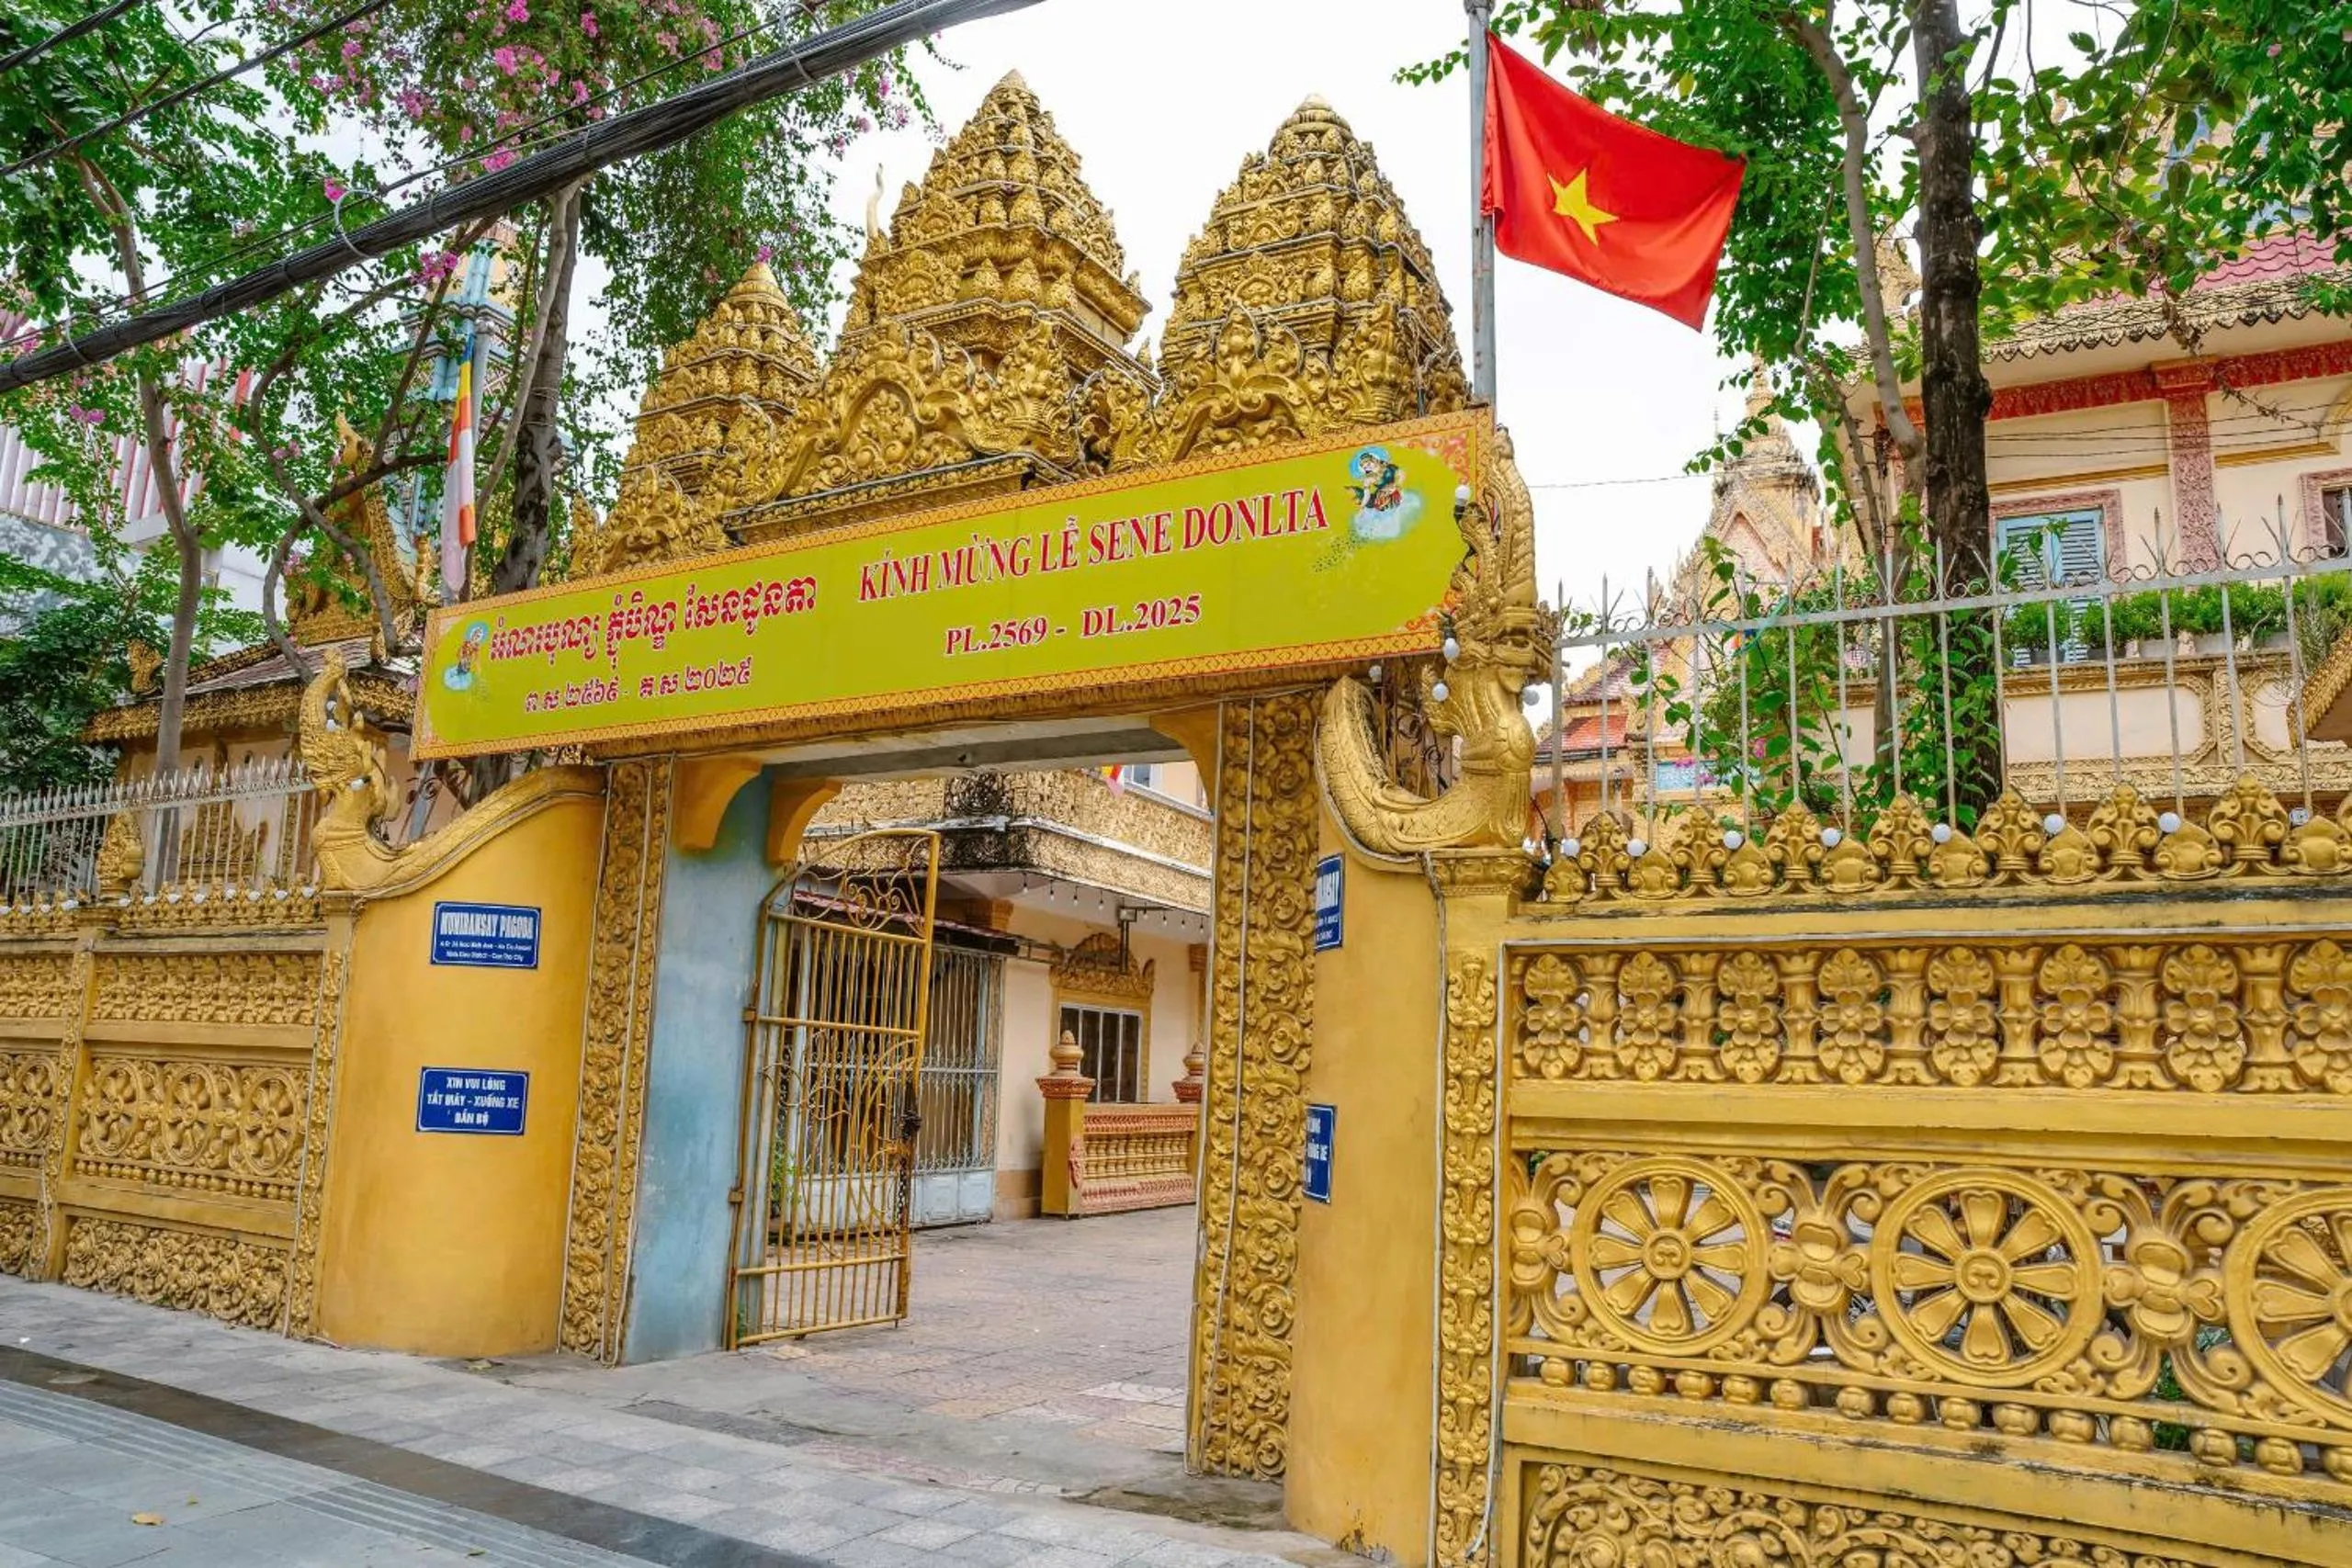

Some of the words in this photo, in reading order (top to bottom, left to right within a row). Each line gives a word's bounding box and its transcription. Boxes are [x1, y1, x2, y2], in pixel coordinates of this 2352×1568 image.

[858, 549, 933, 603] KÍNH
[936, 533, 1031, 589] MỪNG
[1039, 514, 1080, 572] LỄ
[1088, 512, 1173, 565] SENE
[1181, 486, 1329, 551] DONLTA
[944, 616, 1048, 656] PL.2569
[1081, 592, 1203, 638] DL.2025
[499, 915, 534, 939] PAGODA
[447, 1077, 463, 1089] XIN
[465, 1077, 481, 1090] VUI
[506, 1097, 520, 1110] XE
